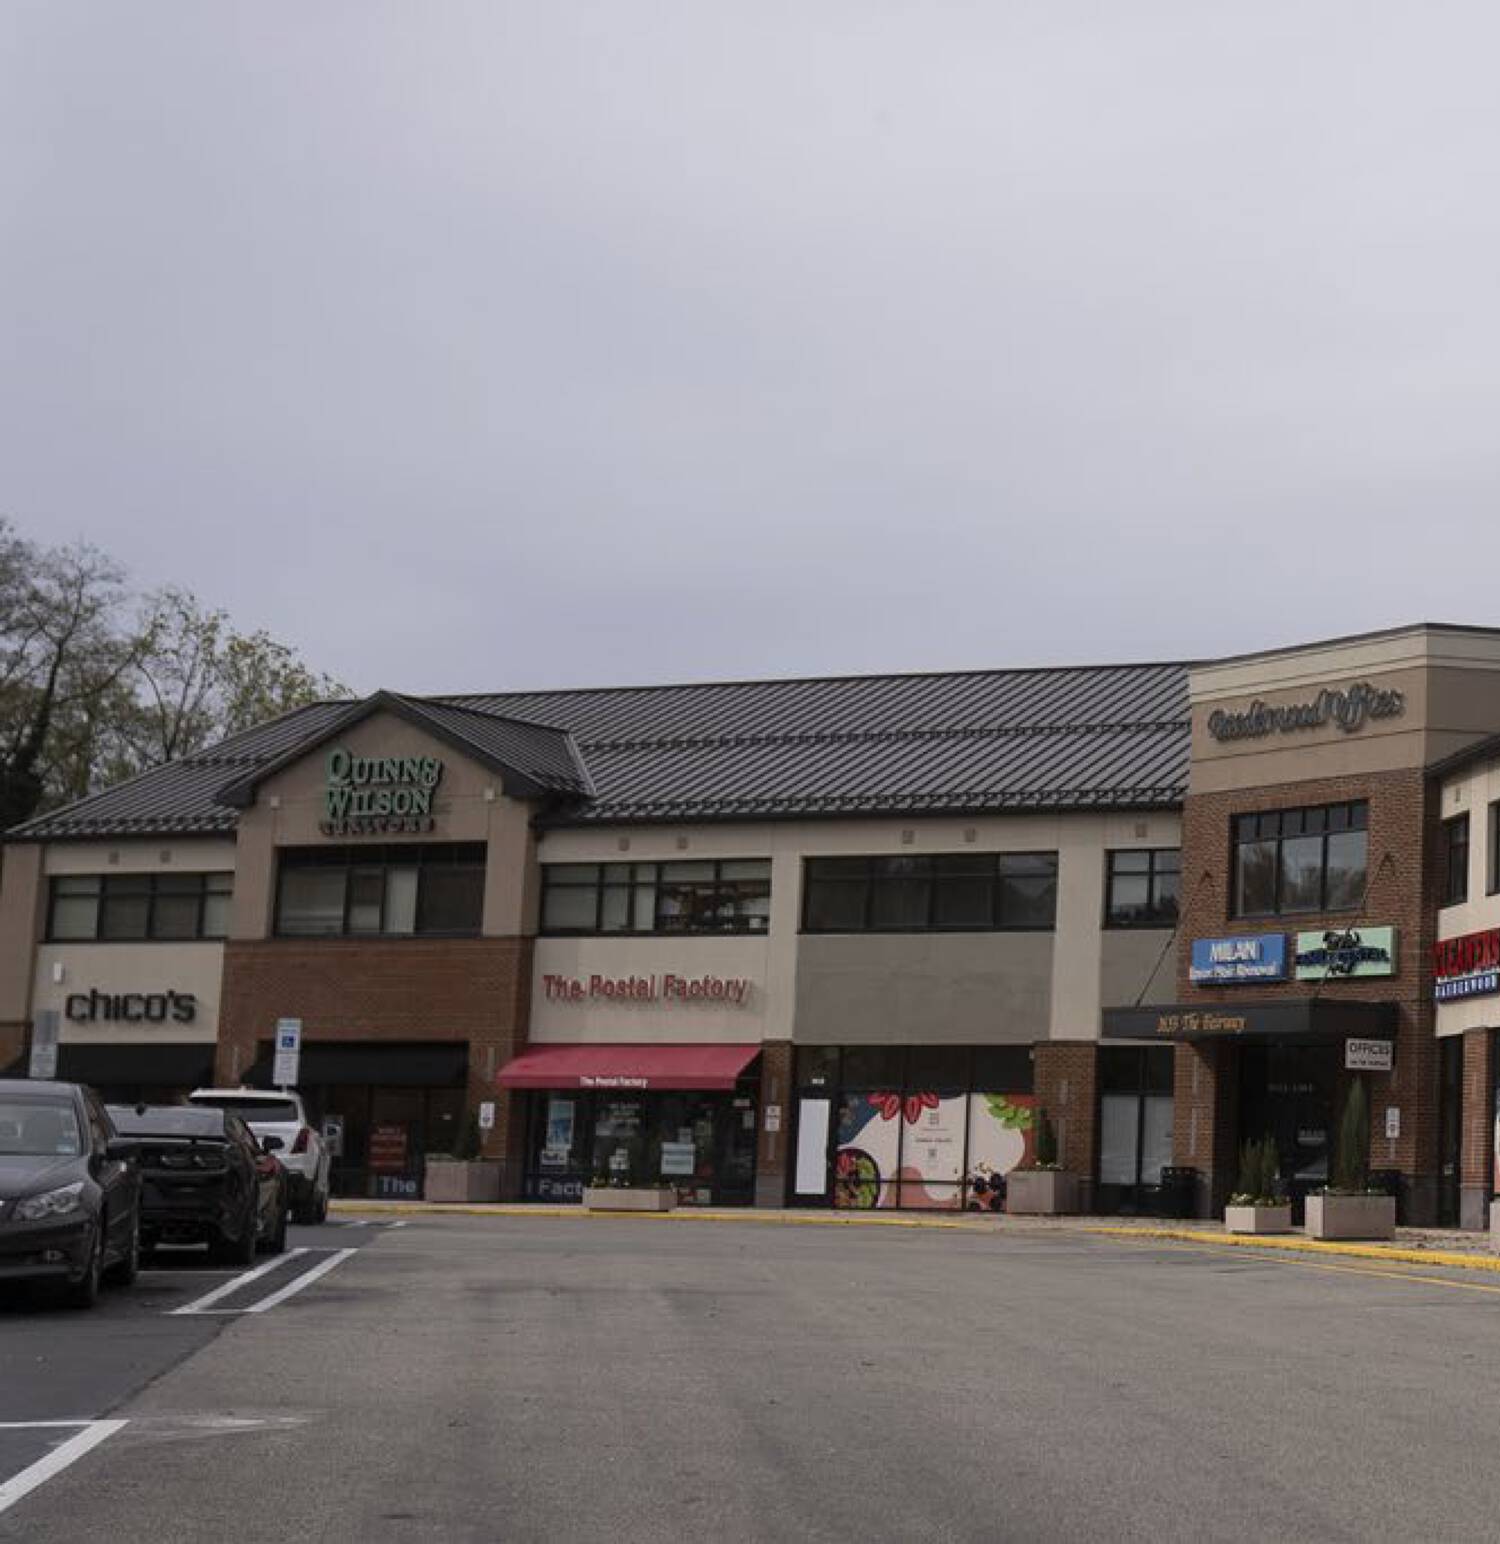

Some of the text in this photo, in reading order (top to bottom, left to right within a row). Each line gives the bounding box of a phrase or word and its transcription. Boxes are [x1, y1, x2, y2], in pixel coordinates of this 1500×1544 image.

[326, 786, 433, 819] WILSON
[1209, 940, 1258, 962] MILAN
[543, 974, 749, 1003] The Postal Factory
[65, 989, 196, 1021] chico's
[379, 1176, 416, 1193] The
